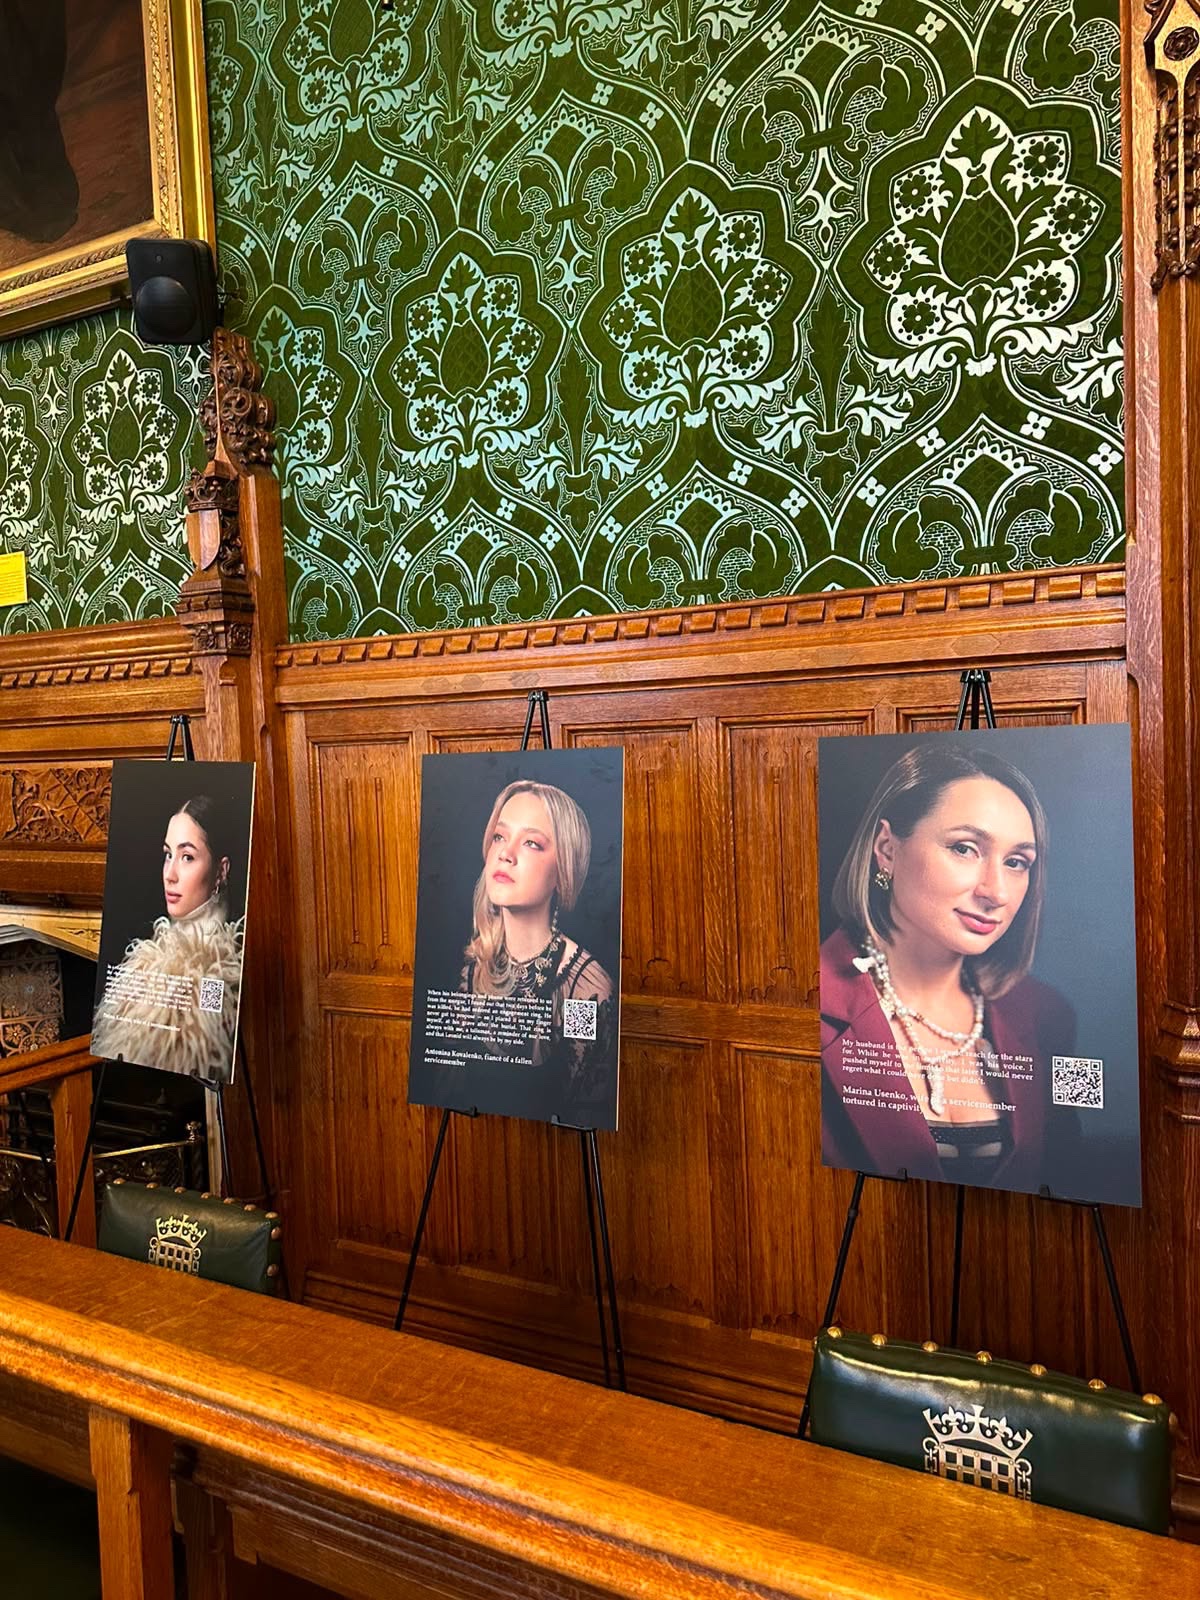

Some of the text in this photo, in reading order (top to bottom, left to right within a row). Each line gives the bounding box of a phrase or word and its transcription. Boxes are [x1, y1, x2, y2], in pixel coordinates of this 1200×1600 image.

[842, 1039, 853, 1047] My
[856, 1040, 885, 1049] husband
[887, 1042, 893, 1050] is
[988, 1051, 999, 1059] for
[858, 1048, 878, 1057] While
[424, 1057, 466, 1066] servicemember
[425, 1048, 450, 1056] Antonina
[452, 1050, 483, 1060] Kovalenko,
[515, 1056, 532, 1065] fallen
[843, 1057, 867, 1065] pushed
[869, 1059, 892, 1067] myself
[986, 1070, 1009, 1078] would
[843, 1065, 863, 1073] regret
[887, 1069, 907, 1077] could
[843, 1085, 872, 1096] Marina
[874, 1088, 908, 1101] Usenko,
[949, 1099, 1016, 1112] servicemember
[843, 1096, 875, 1107] tortured
[878, 1100, 886, 1108] in
